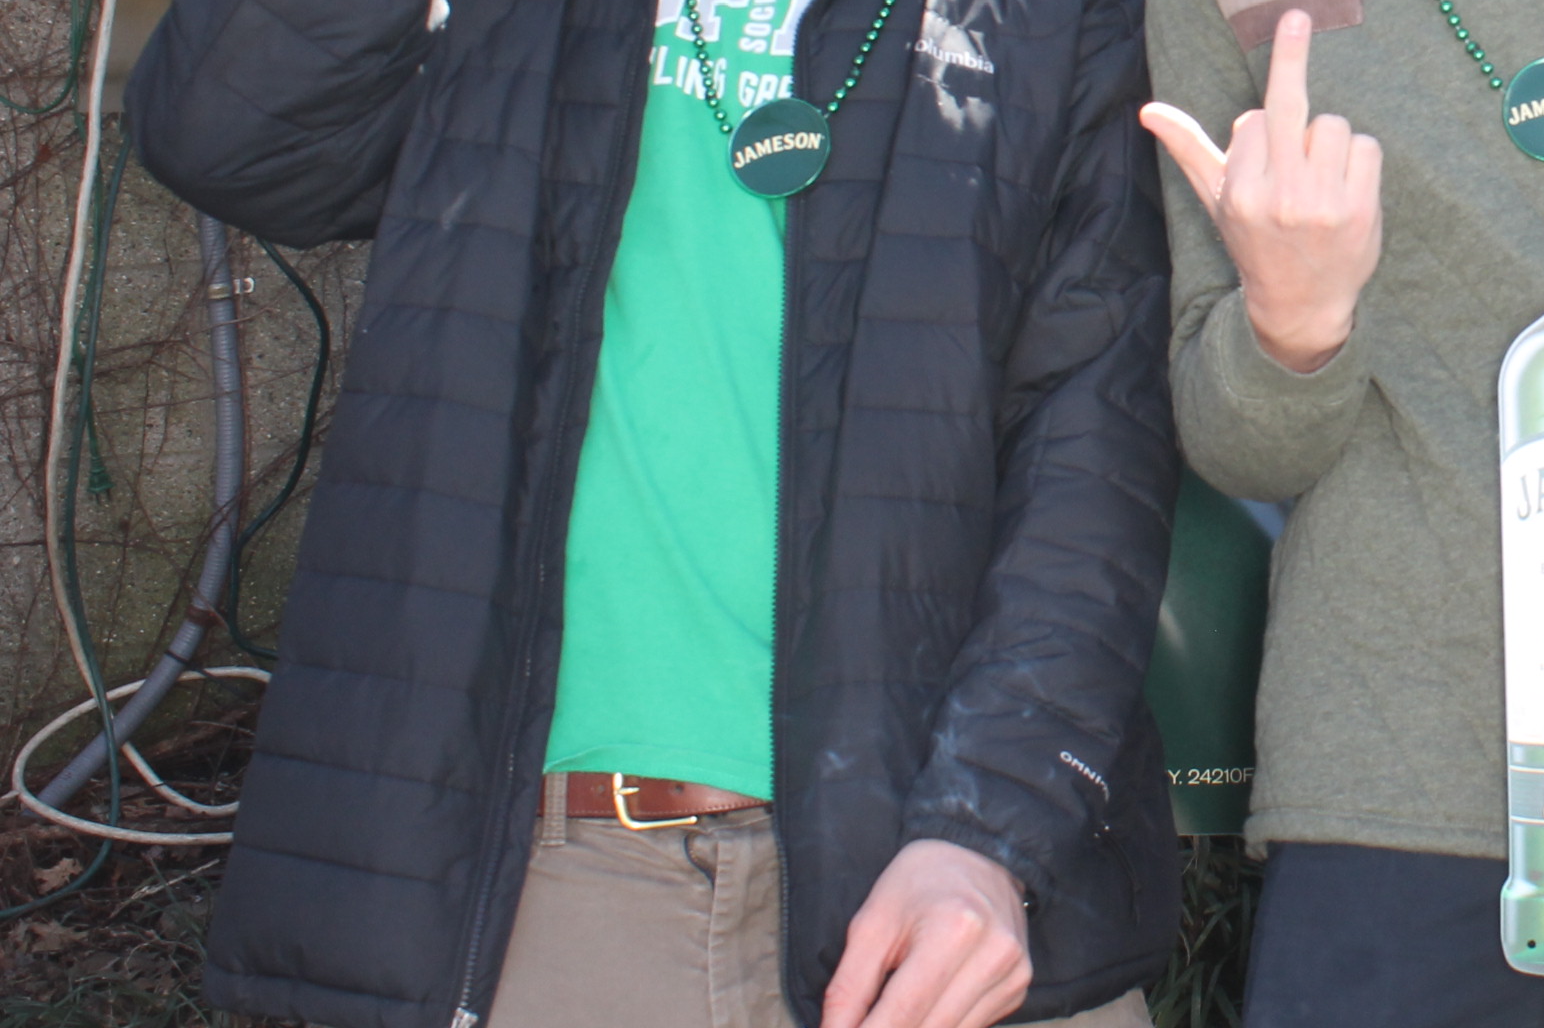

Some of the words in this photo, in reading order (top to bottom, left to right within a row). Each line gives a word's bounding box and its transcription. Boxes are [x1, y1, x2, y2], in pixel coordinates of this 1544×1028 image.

[649, 45, 728, 101] LING
[737, 70, 794, 109] GRE
[733, 131, 821, 169] JAMESON
